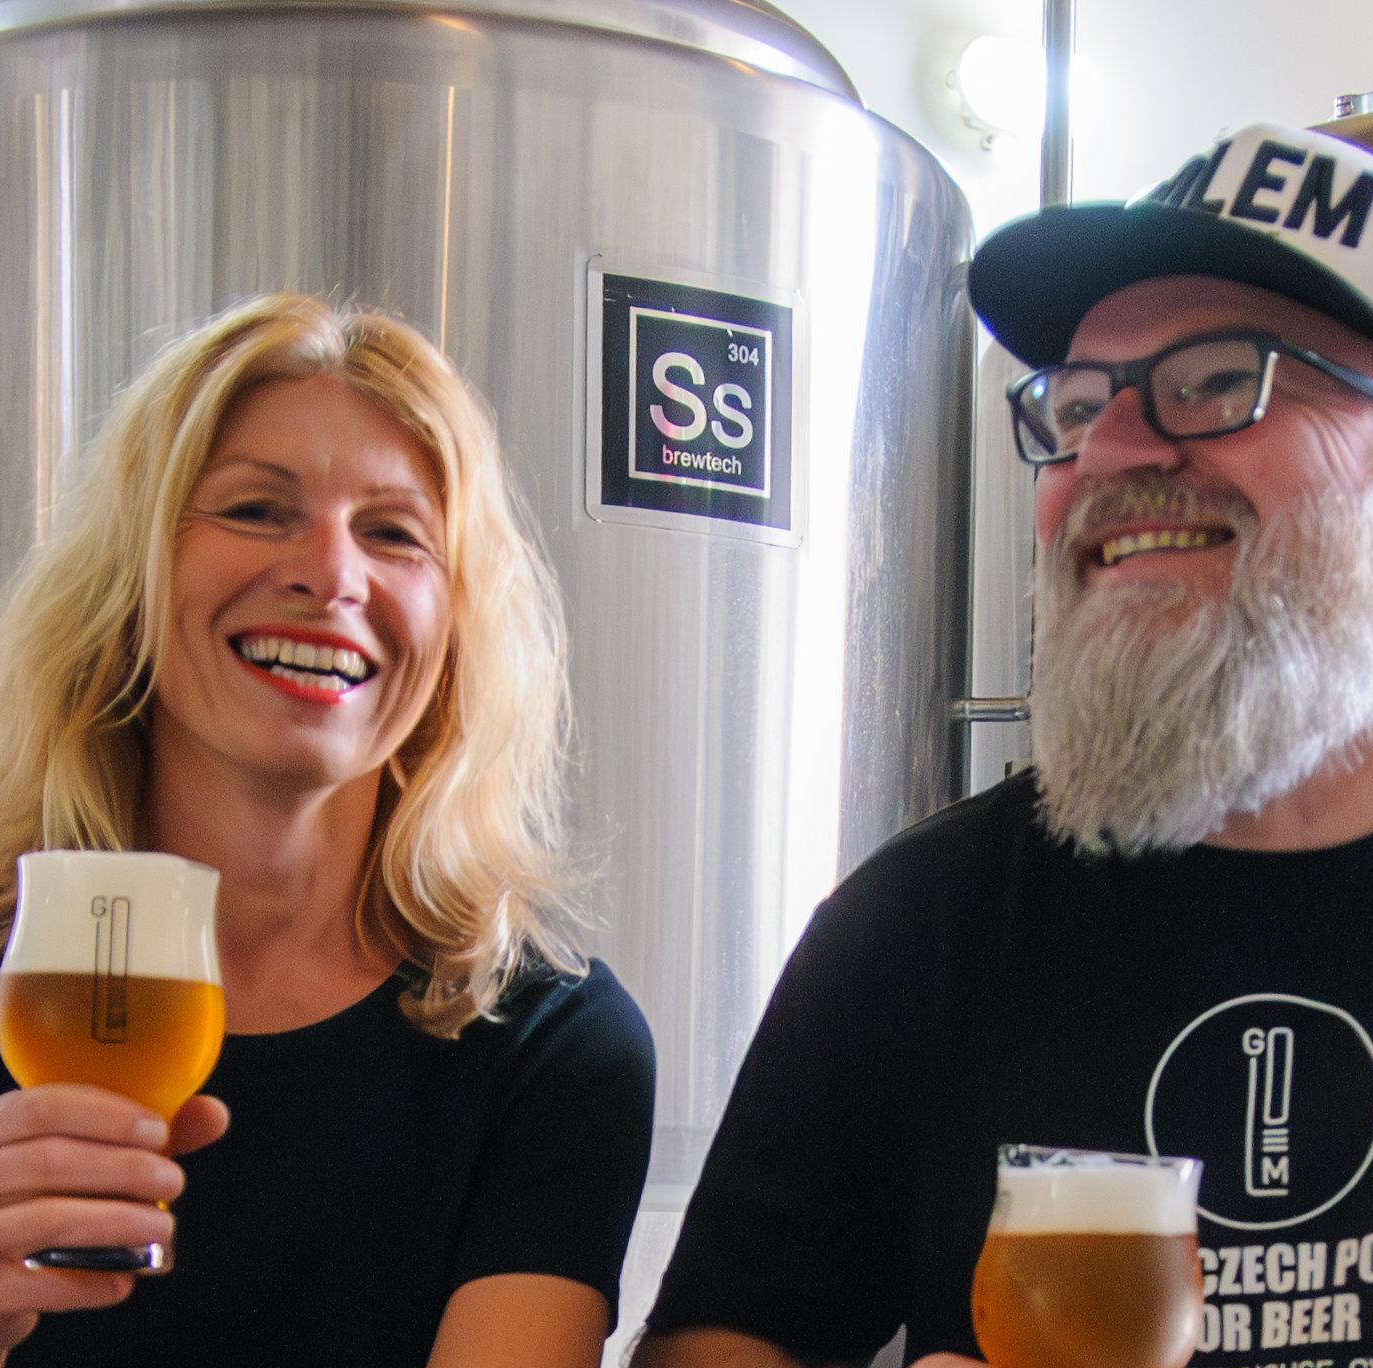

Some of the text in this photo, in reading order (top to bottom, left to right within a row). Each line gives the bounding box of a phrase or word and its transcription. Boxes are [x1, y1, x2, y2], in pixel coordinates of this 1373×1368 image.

[728, 343, 759, 366] 304
[650, 351, 753, 448] Ss
[662, 445, 742, 475] brewtech
[1194, 1293, 1362, 1353] OR BEER
